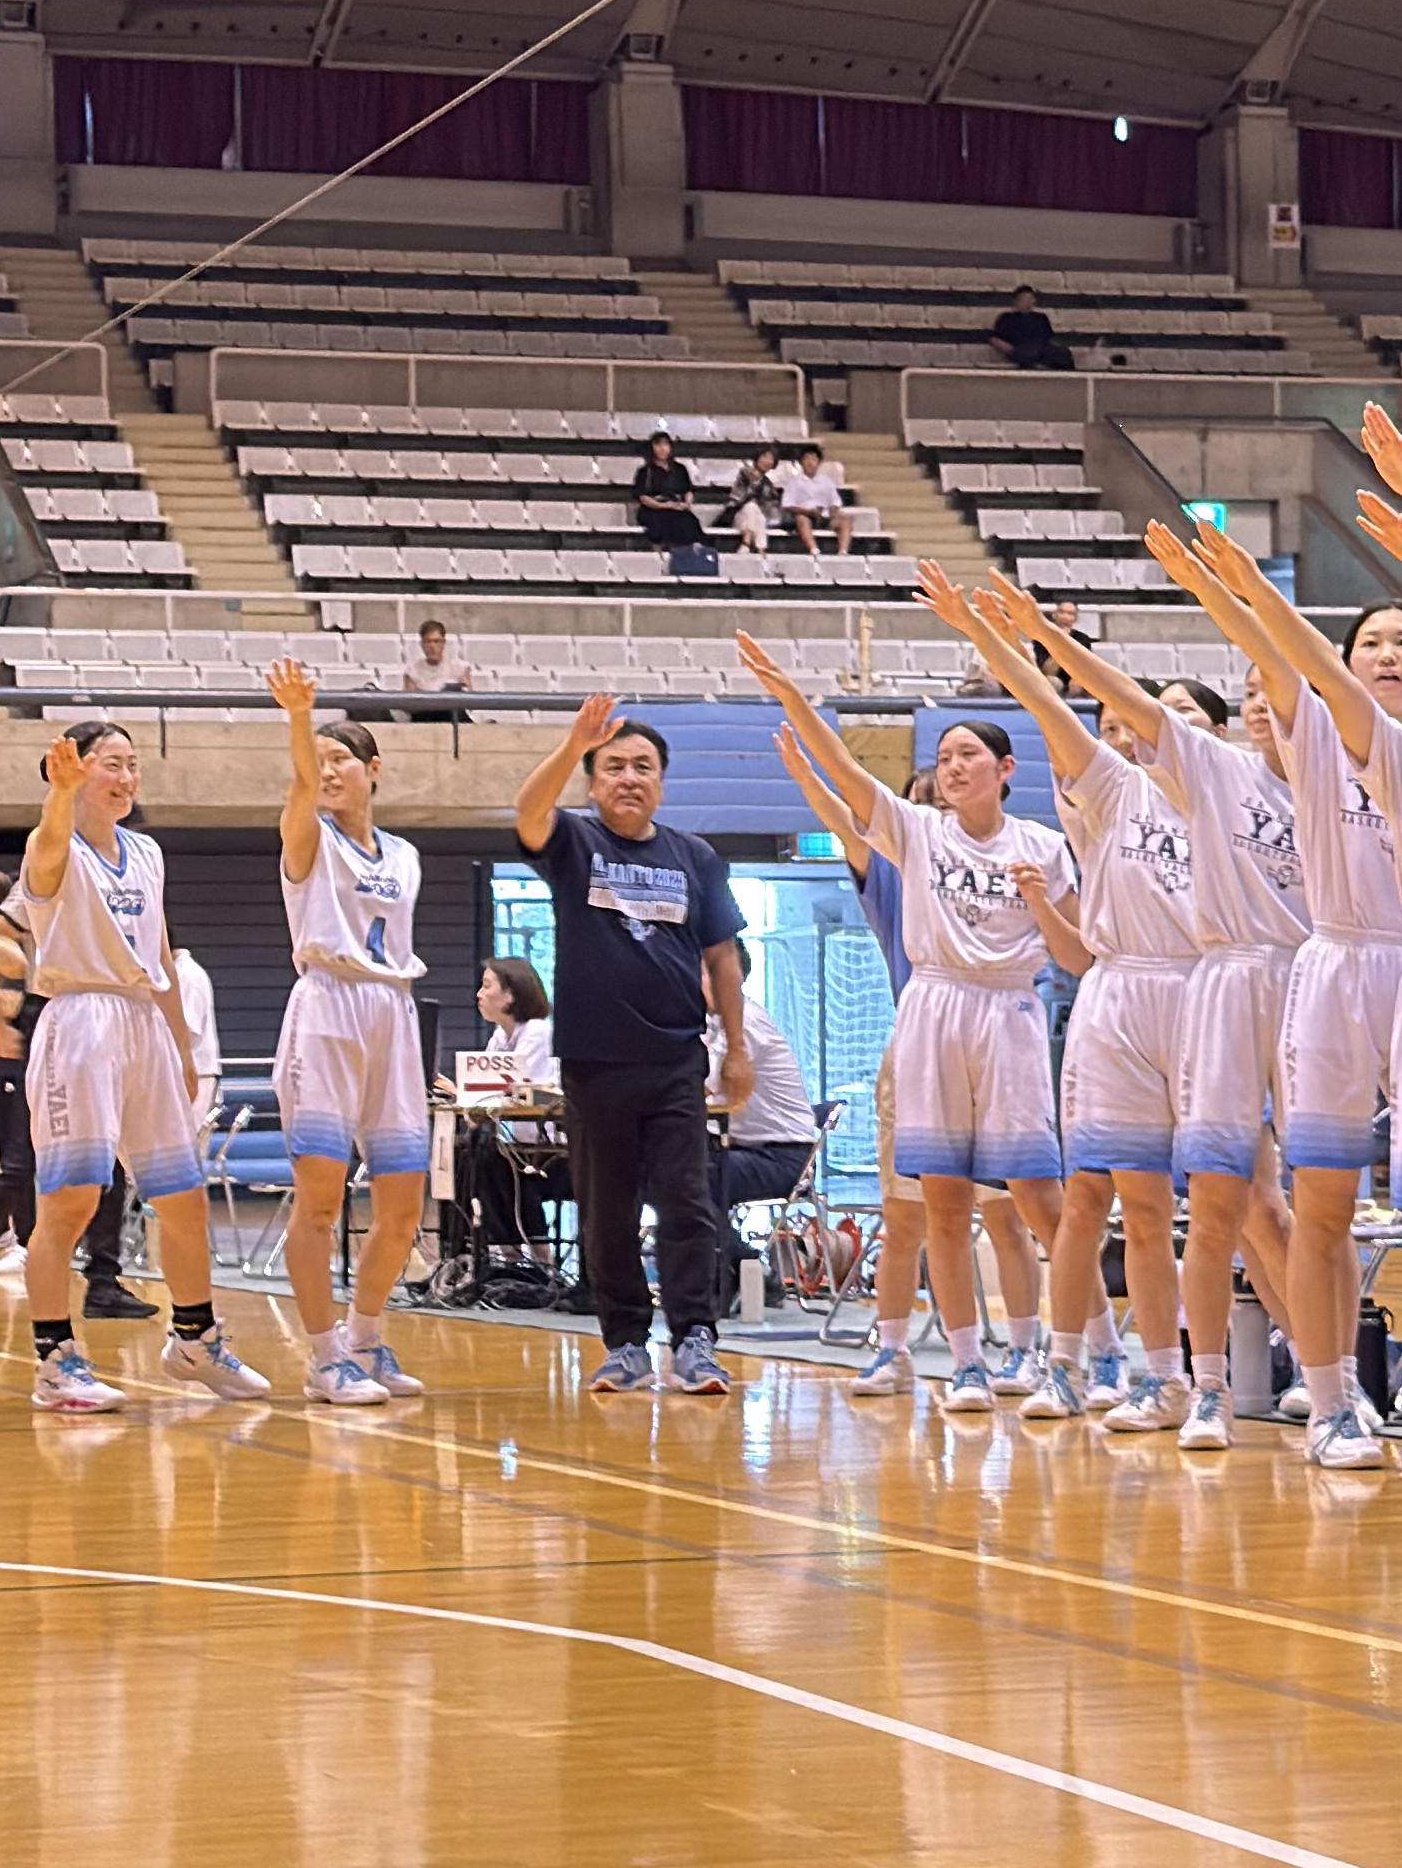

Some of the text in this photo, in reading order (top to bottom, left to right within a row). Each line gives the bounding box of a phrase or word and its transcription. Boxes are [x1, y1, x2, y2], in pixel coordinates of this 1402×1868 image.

[1137, 824, 1191, 863] YA
[1250, 812, 1295, 851] YA
[47, 1084, 70, 1138] YAEI
